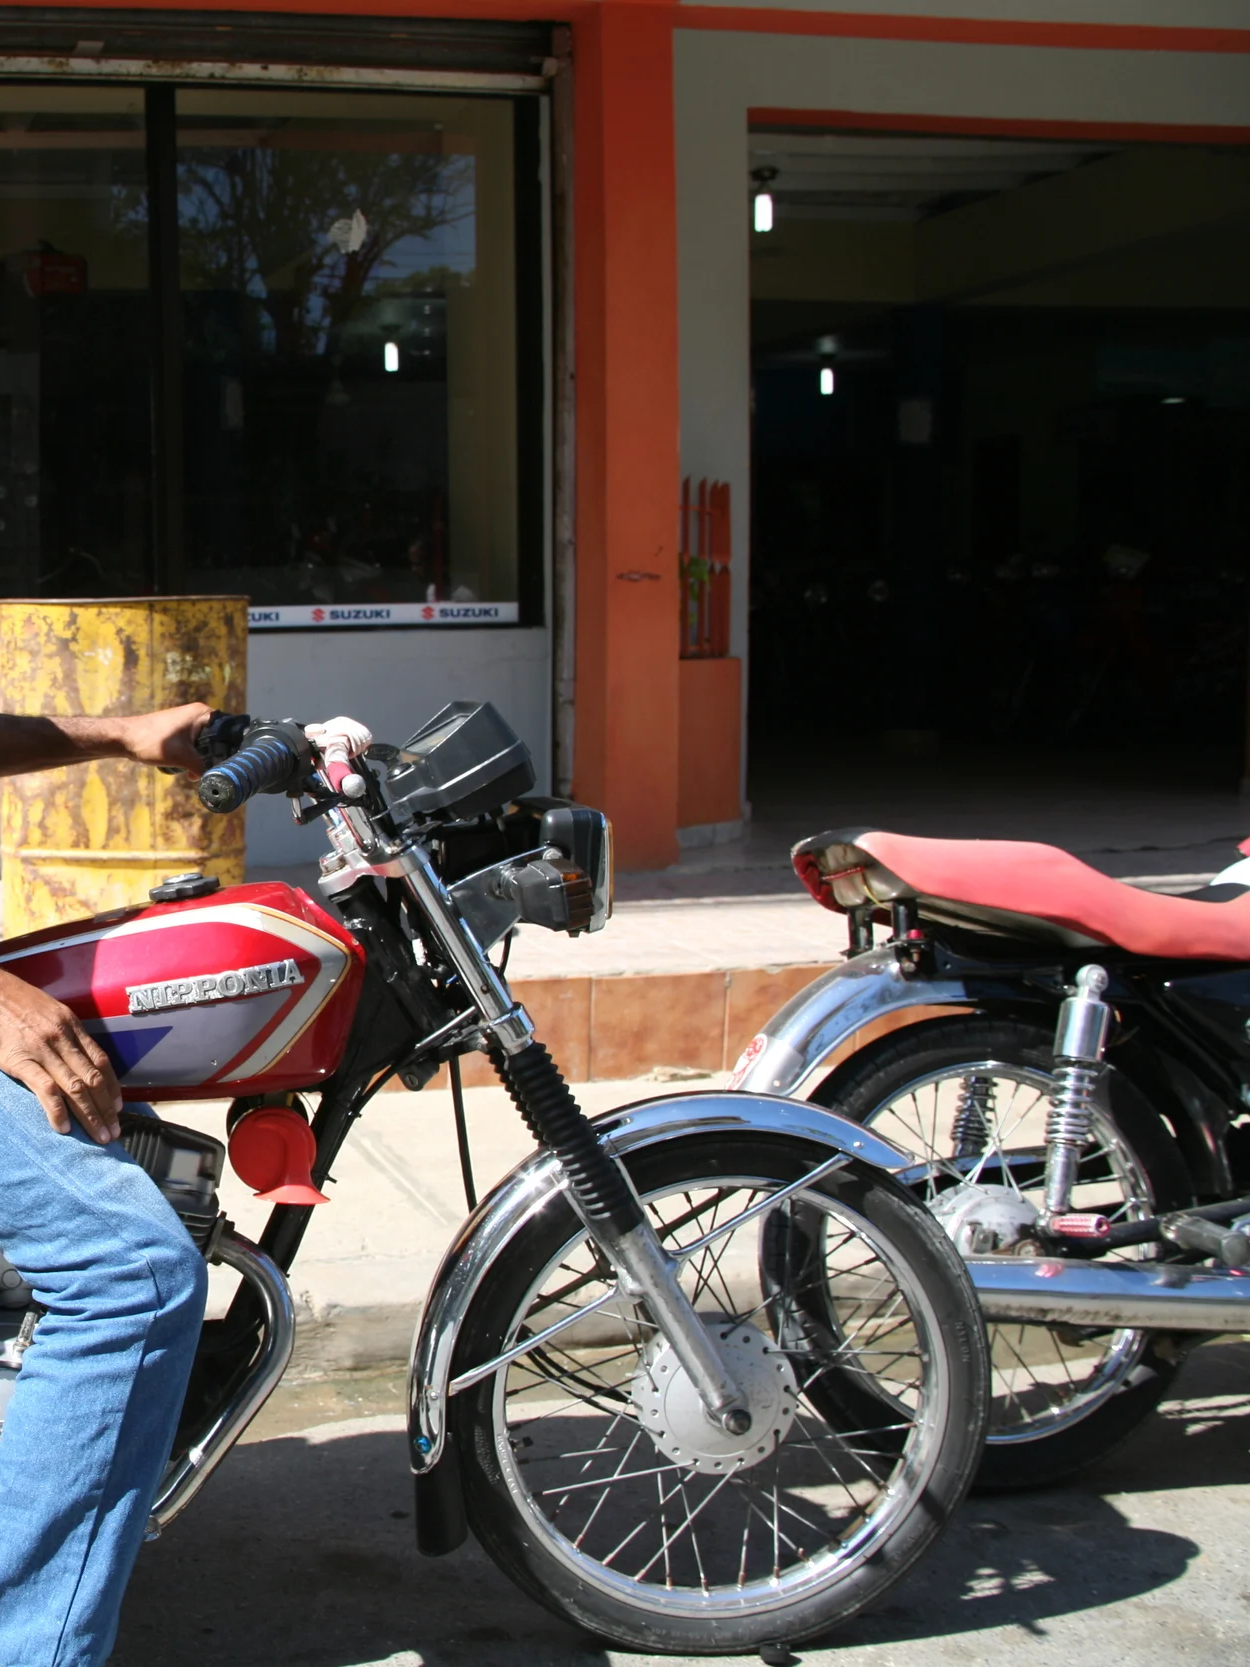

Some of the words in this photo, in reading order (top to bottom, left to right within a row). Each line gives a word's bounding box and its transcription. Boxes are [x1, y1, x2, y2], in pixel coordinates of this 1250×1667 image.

[329, 609, 391, 620] SUZUKI
[438, 607, 499, 618] SUZUKI
[126, 958, 305, 1013] NIPPONIA
